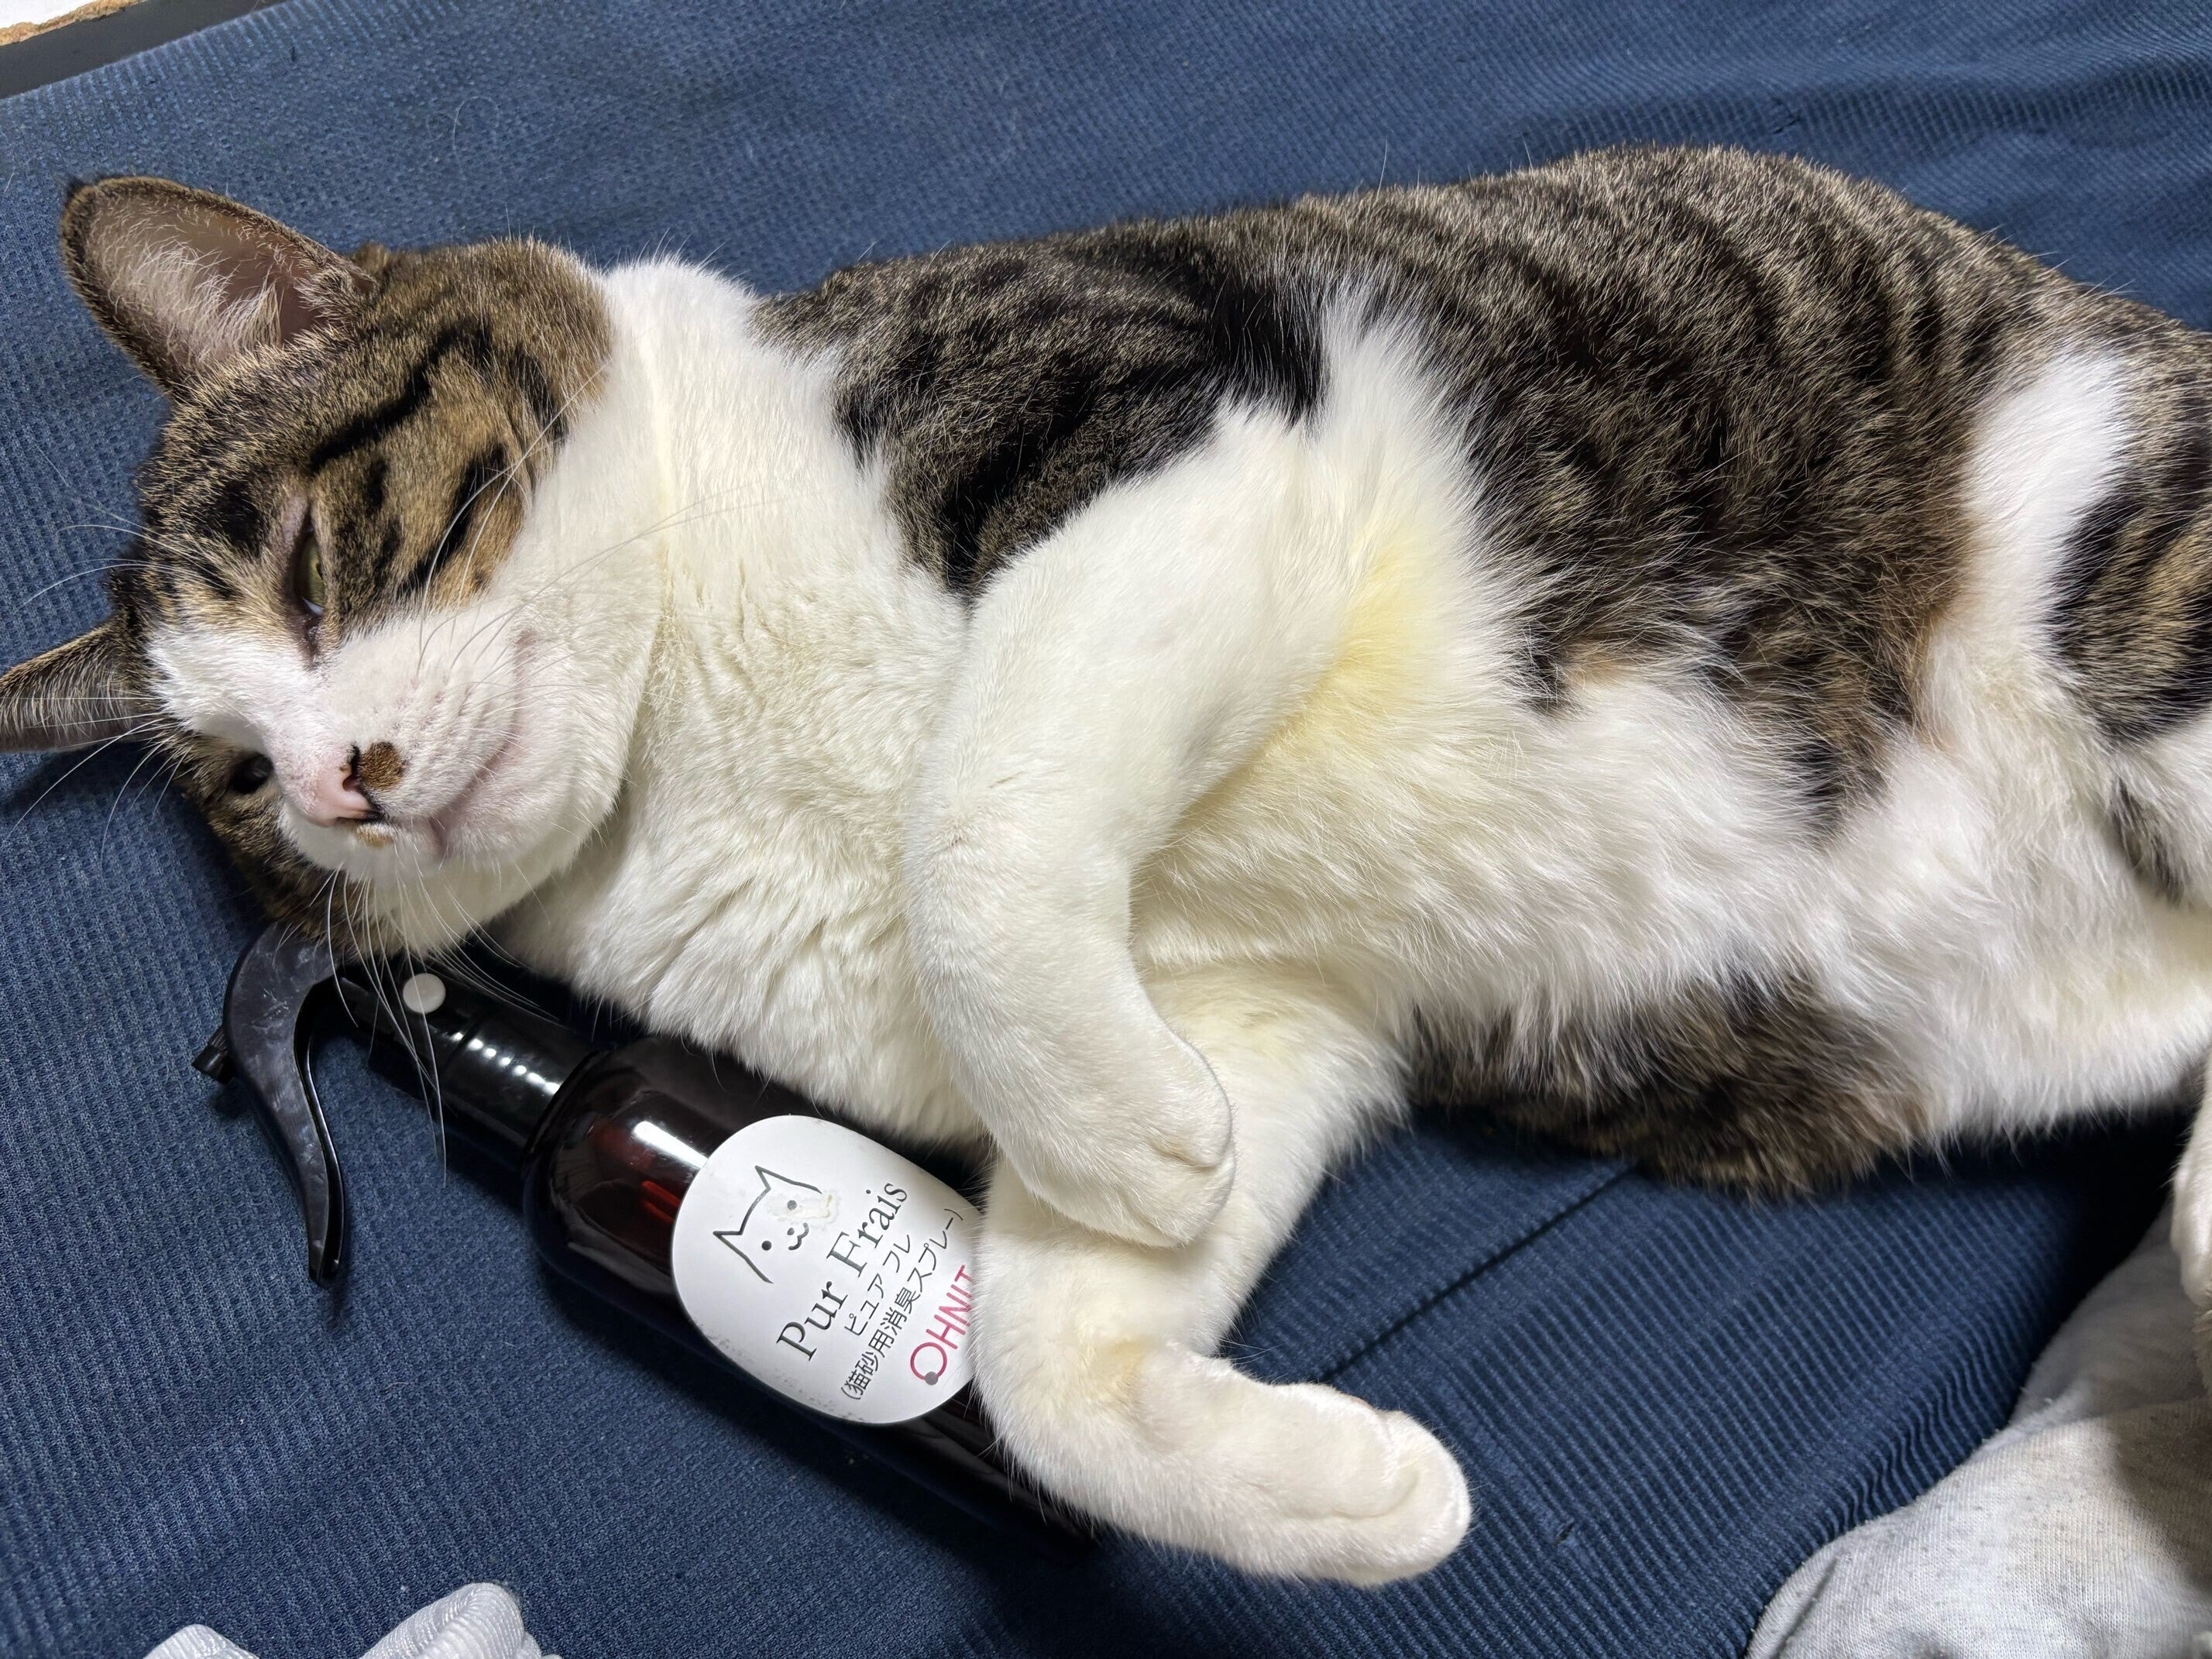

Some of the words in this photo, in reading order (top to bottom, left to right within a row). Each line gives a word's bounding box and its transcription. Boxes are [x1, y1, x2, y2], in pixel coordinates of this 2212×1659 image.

[776, 1280, 848, 1362] Pur
[826, 1183, 907, 1278] Frais
[841, 1208, 963, 1400] (猫砂用消臭スプレー)
